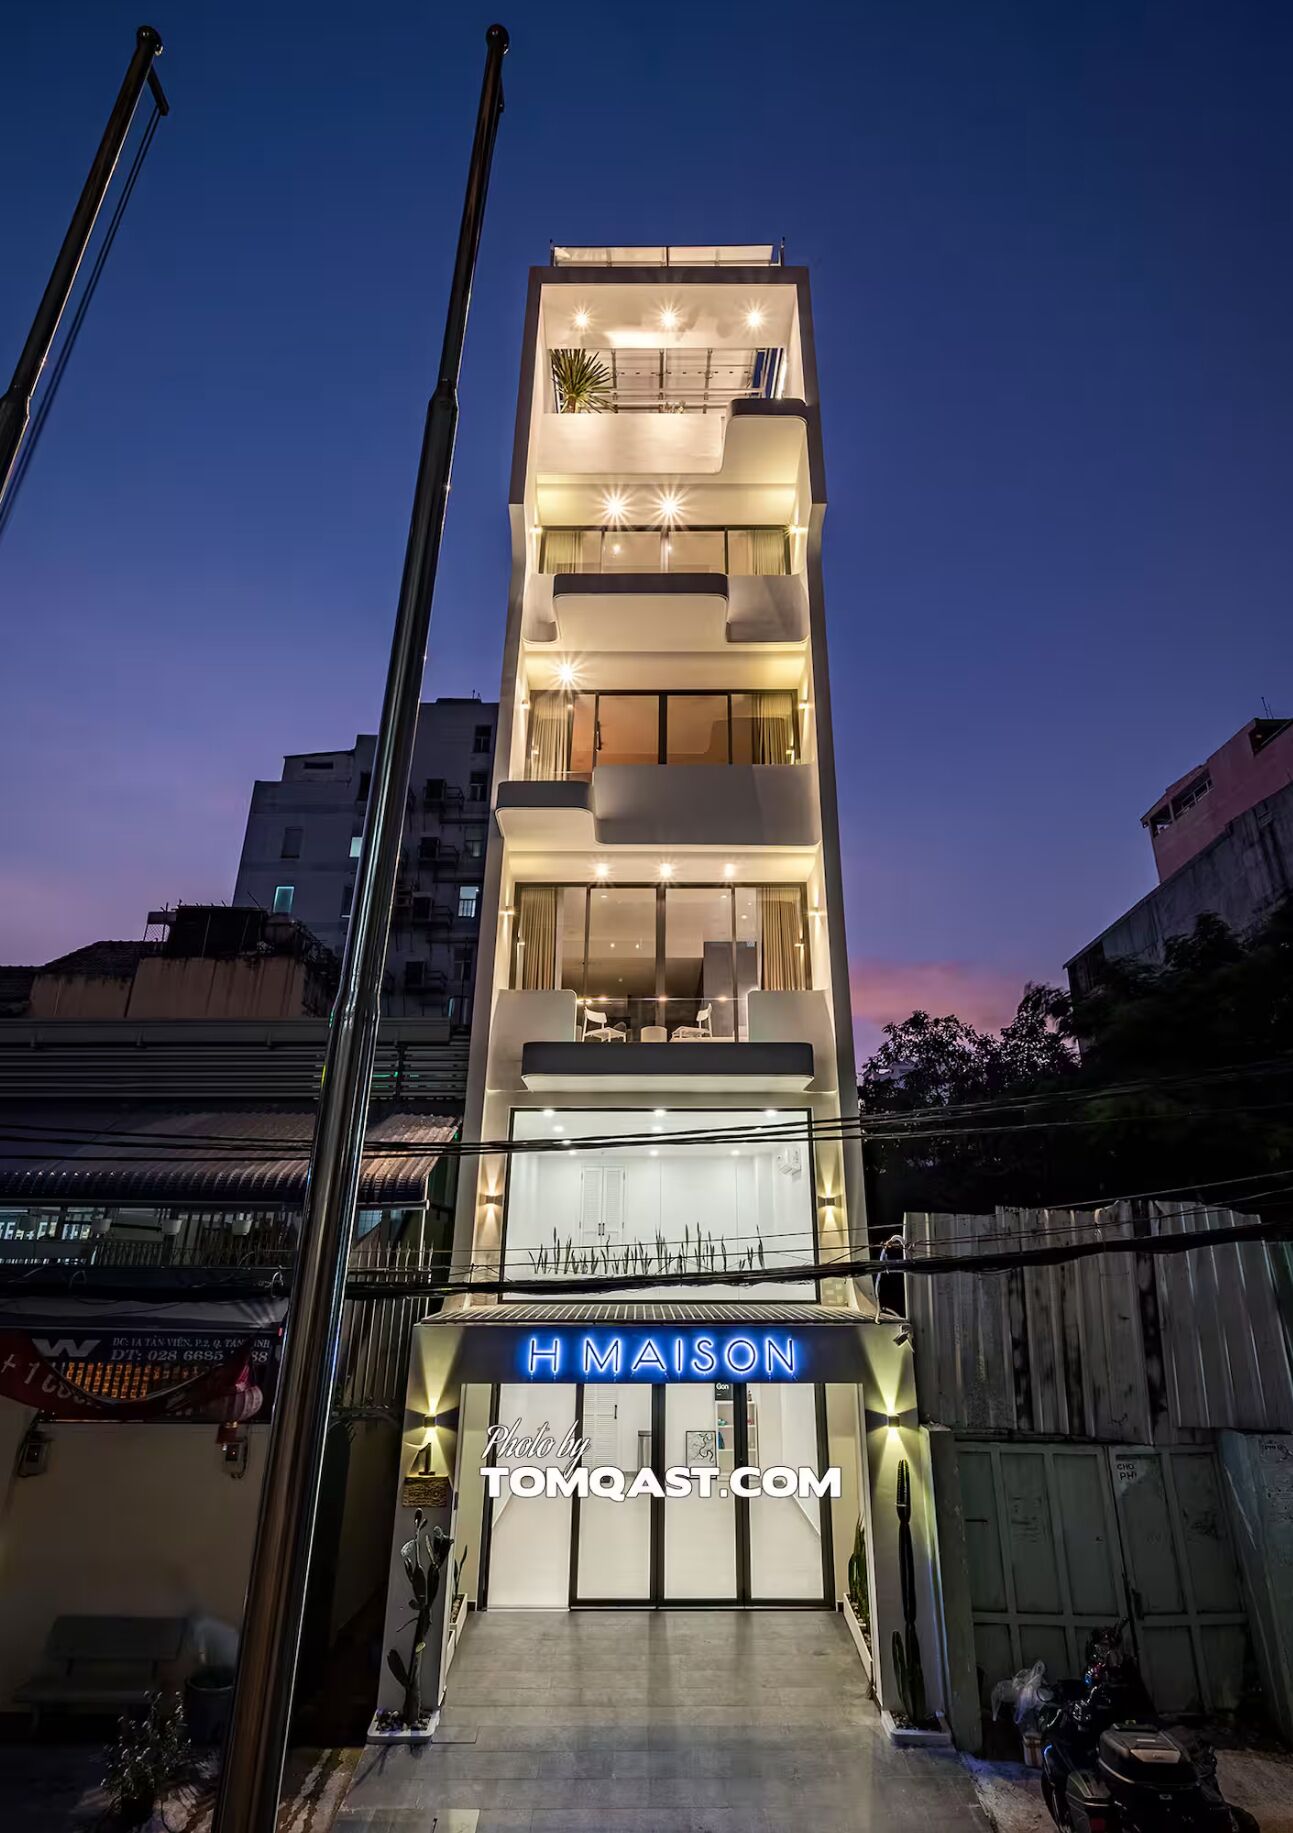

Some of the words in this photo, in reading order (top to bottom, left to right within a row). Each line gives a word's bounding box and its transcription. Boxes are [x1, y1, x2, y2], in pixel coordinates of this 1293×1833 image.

[147, 1350, 177, 1361] 028
[528, 1339, 560, 1373] H
[583, 1338, 797, 1373] MAISON
